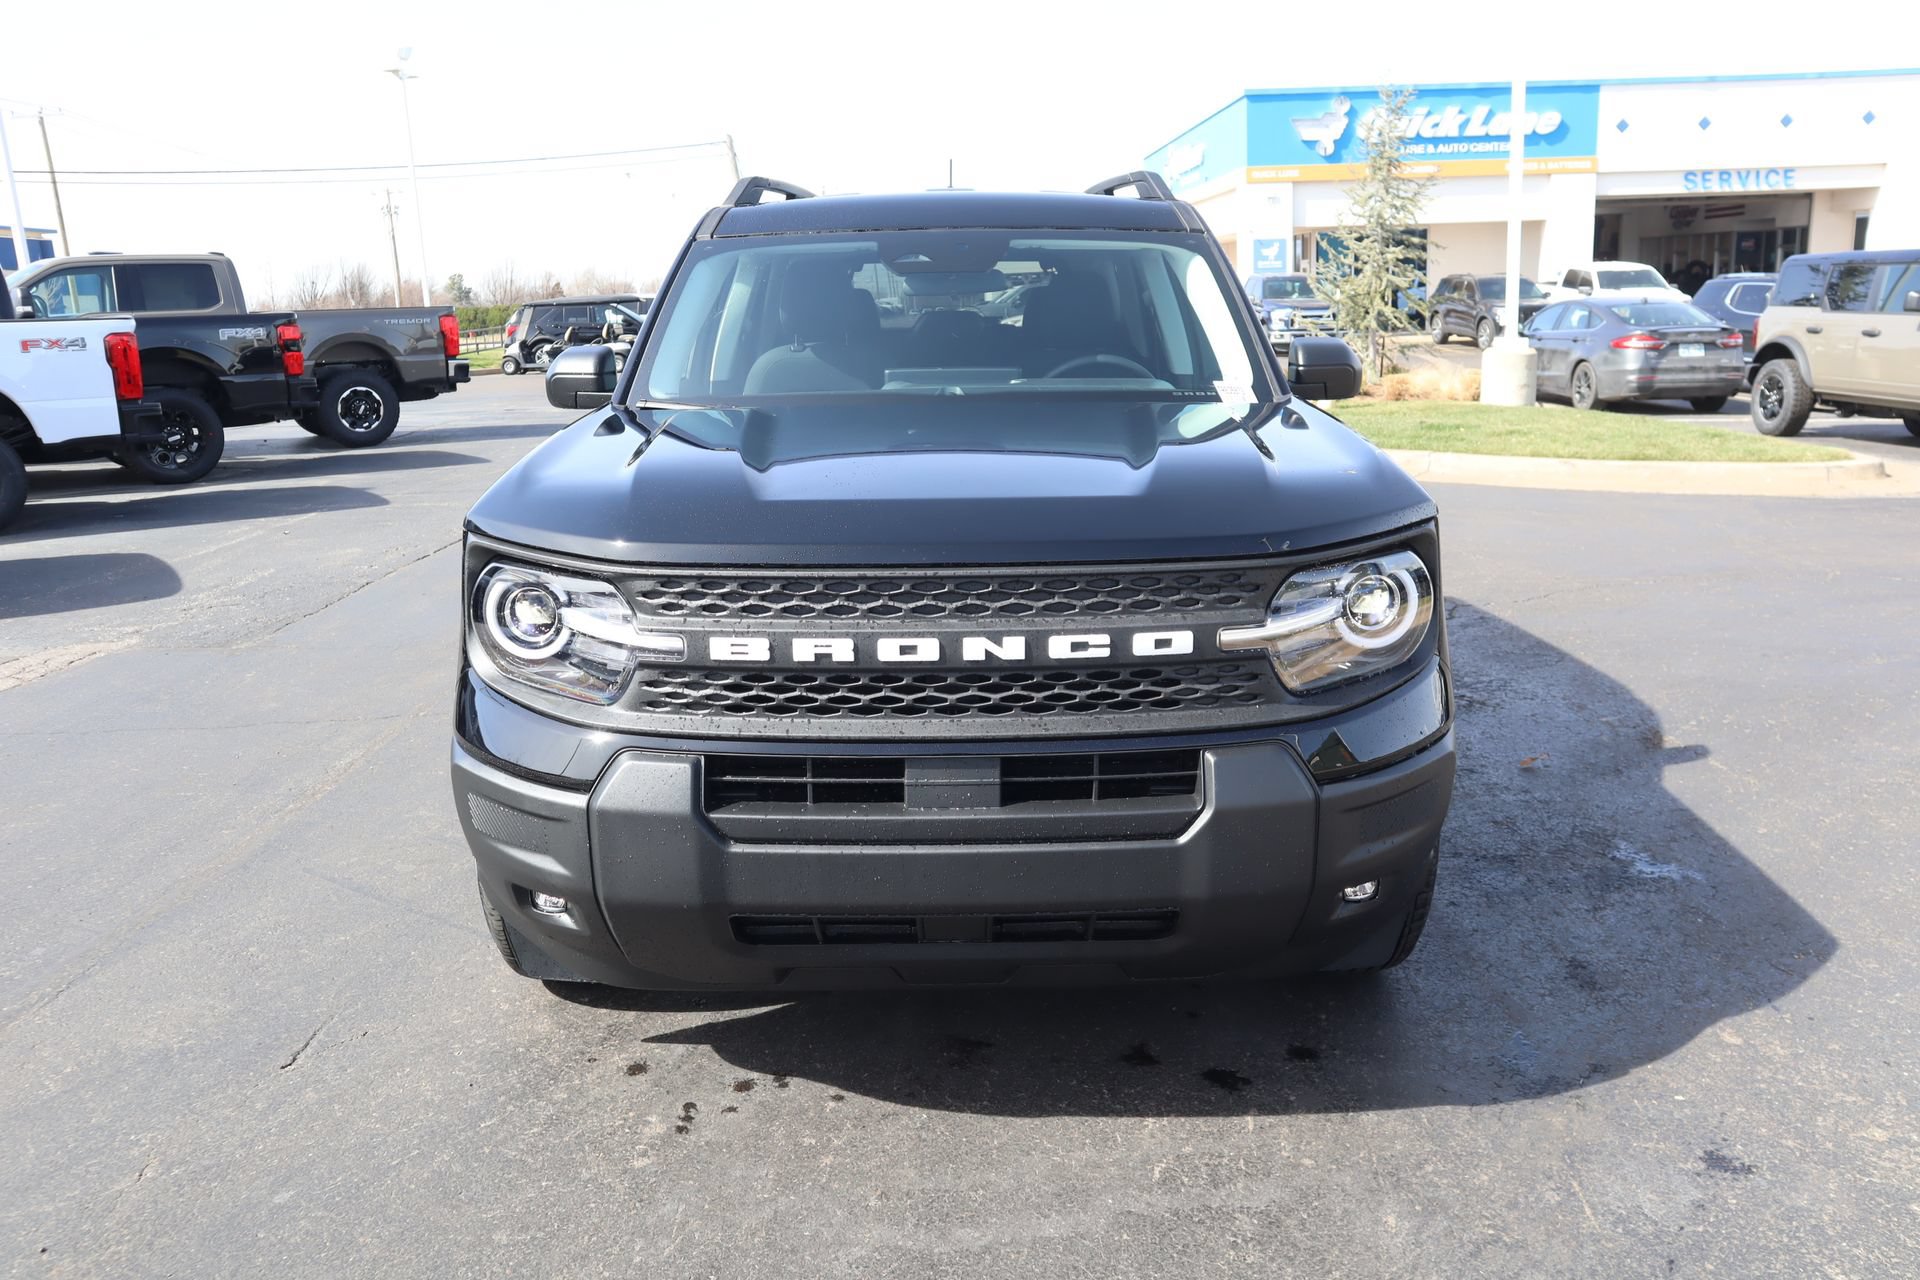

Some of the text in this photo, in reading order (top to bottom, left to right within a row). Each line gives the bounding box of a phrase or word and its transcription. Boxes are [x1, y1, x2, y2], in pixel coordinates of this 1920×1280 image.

[1427, 144, 1436, 153] &
[1437, 143, 1469, 153] AUTO
[1470, 141, 1511, 152] CENTE
[1683, 168, 1796, 191] SERVICE
[383, 317, 431, 325] TREMOR
[218, 327, 267, 341] FX4
[20, 336, 87, 353] FX4
[709, 630, 1194, 662] BRONCO
